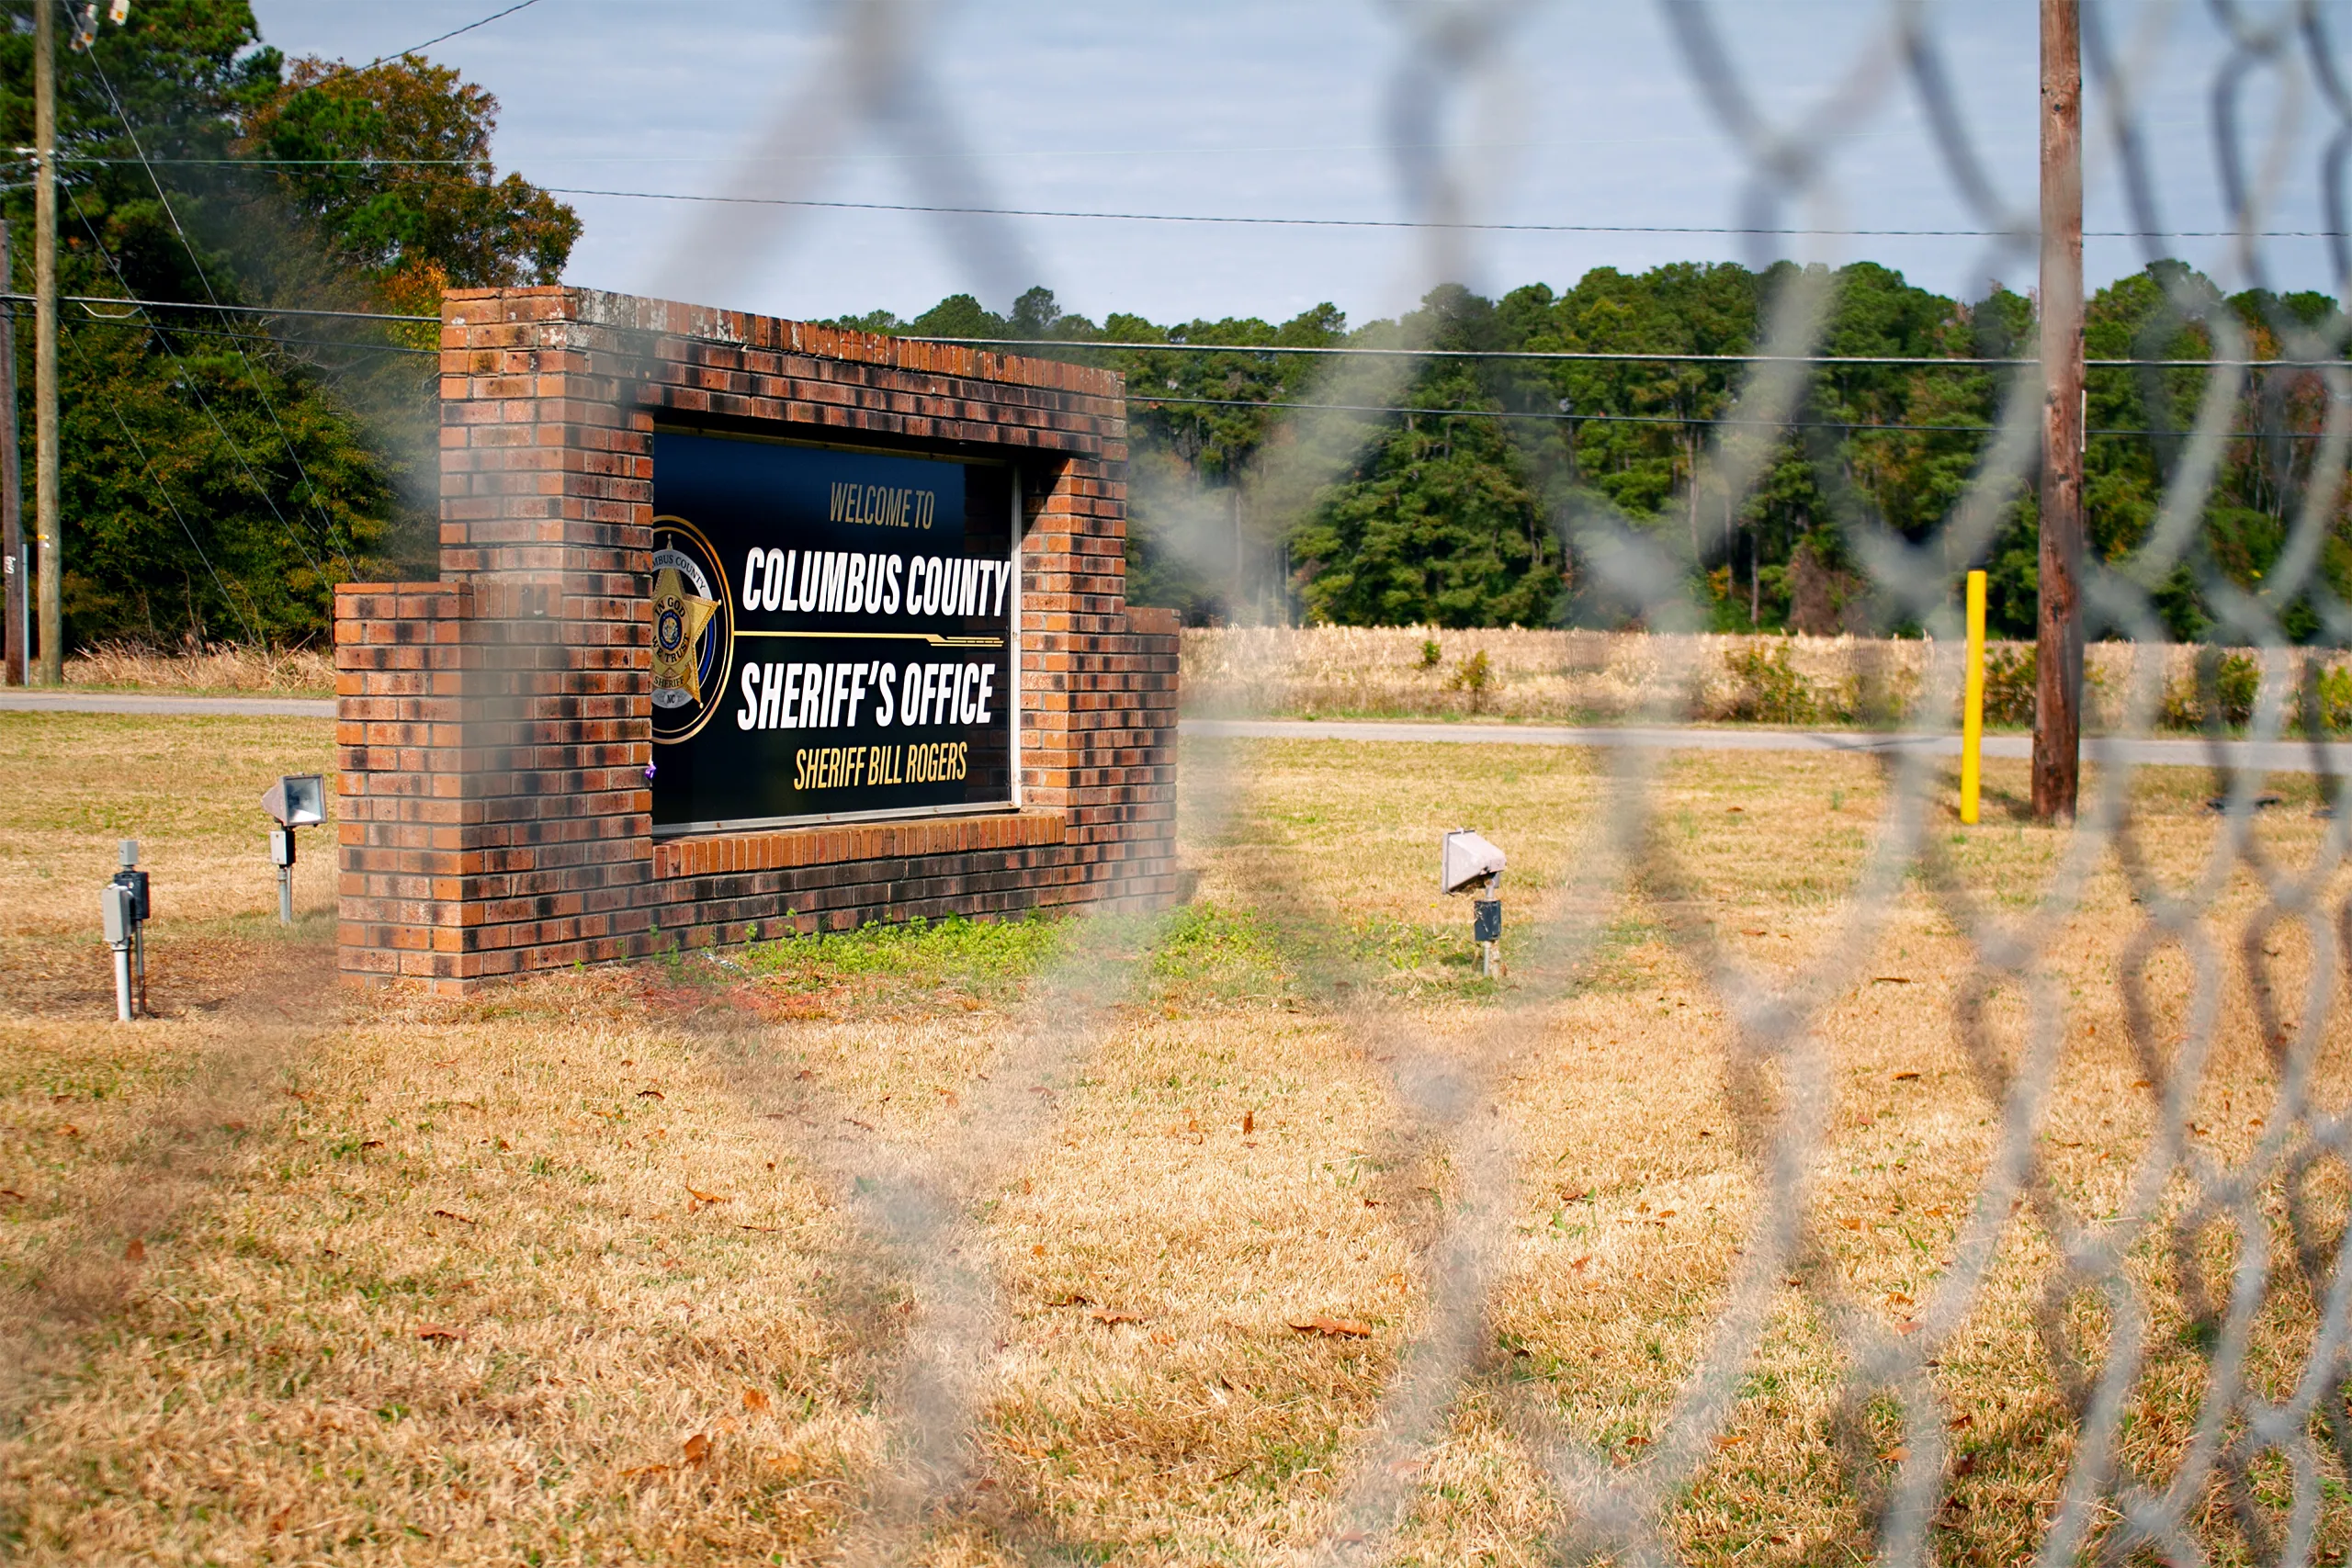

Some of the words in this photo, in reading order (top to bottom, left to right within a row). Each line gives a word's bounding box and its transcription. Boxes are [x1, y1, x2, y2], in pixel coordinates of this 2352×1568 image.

[830, 481, 910, 528] WELCOME
[912, 490, 935, 530] TO
[675, 557, 706, 589] COUNTY
[742, 547, 902, 615] COLUMBUS
[906, 556, 1011, 616] COUNTY
[654, 600, 665, 616] IN
[667, 597, 685, 617] GOD
[652, 635, 662, 658] WE
[664, 633, 689, 664] TRUST
[653, 676, 684, 689] SHERIFF
[737, 660, 896, 731] SHERIFF'S
[900, 662, 995, 725] OFFICE
[794, 746, 865, 790] SHERIFF
[867, 745, 902, 786] BILL
[906, 741, 967, 784] ROGERS
